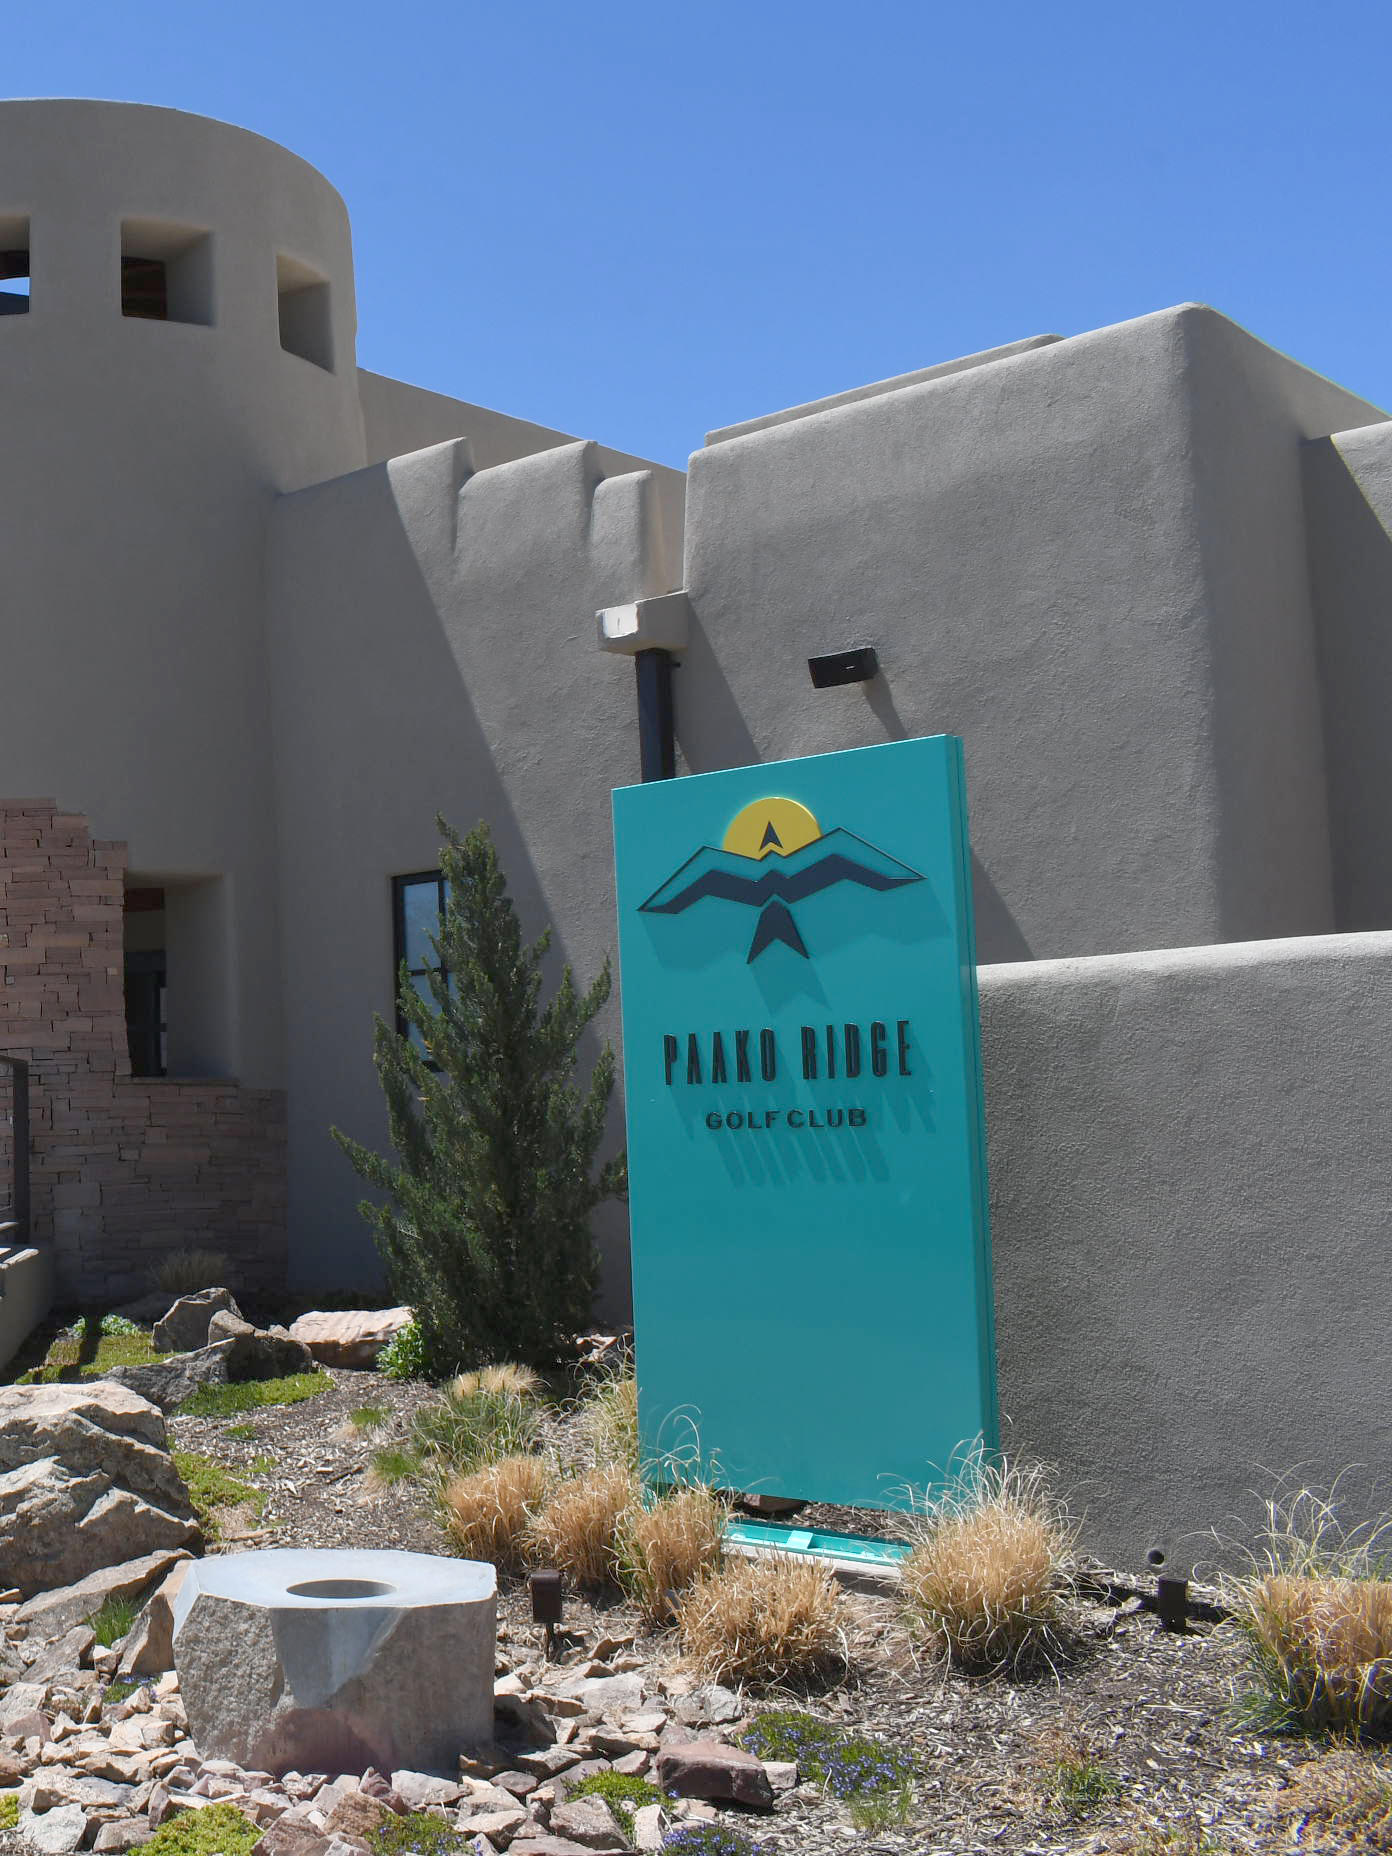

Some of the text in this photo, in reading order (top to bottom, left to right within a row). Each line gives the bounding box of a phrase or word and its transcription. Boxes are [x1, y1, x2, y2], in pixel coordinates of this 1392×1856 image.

[663, 1020, 912, 1086] PAAKO RIDGE
[705, 1108, 867, 1130] GOLF CLUB
